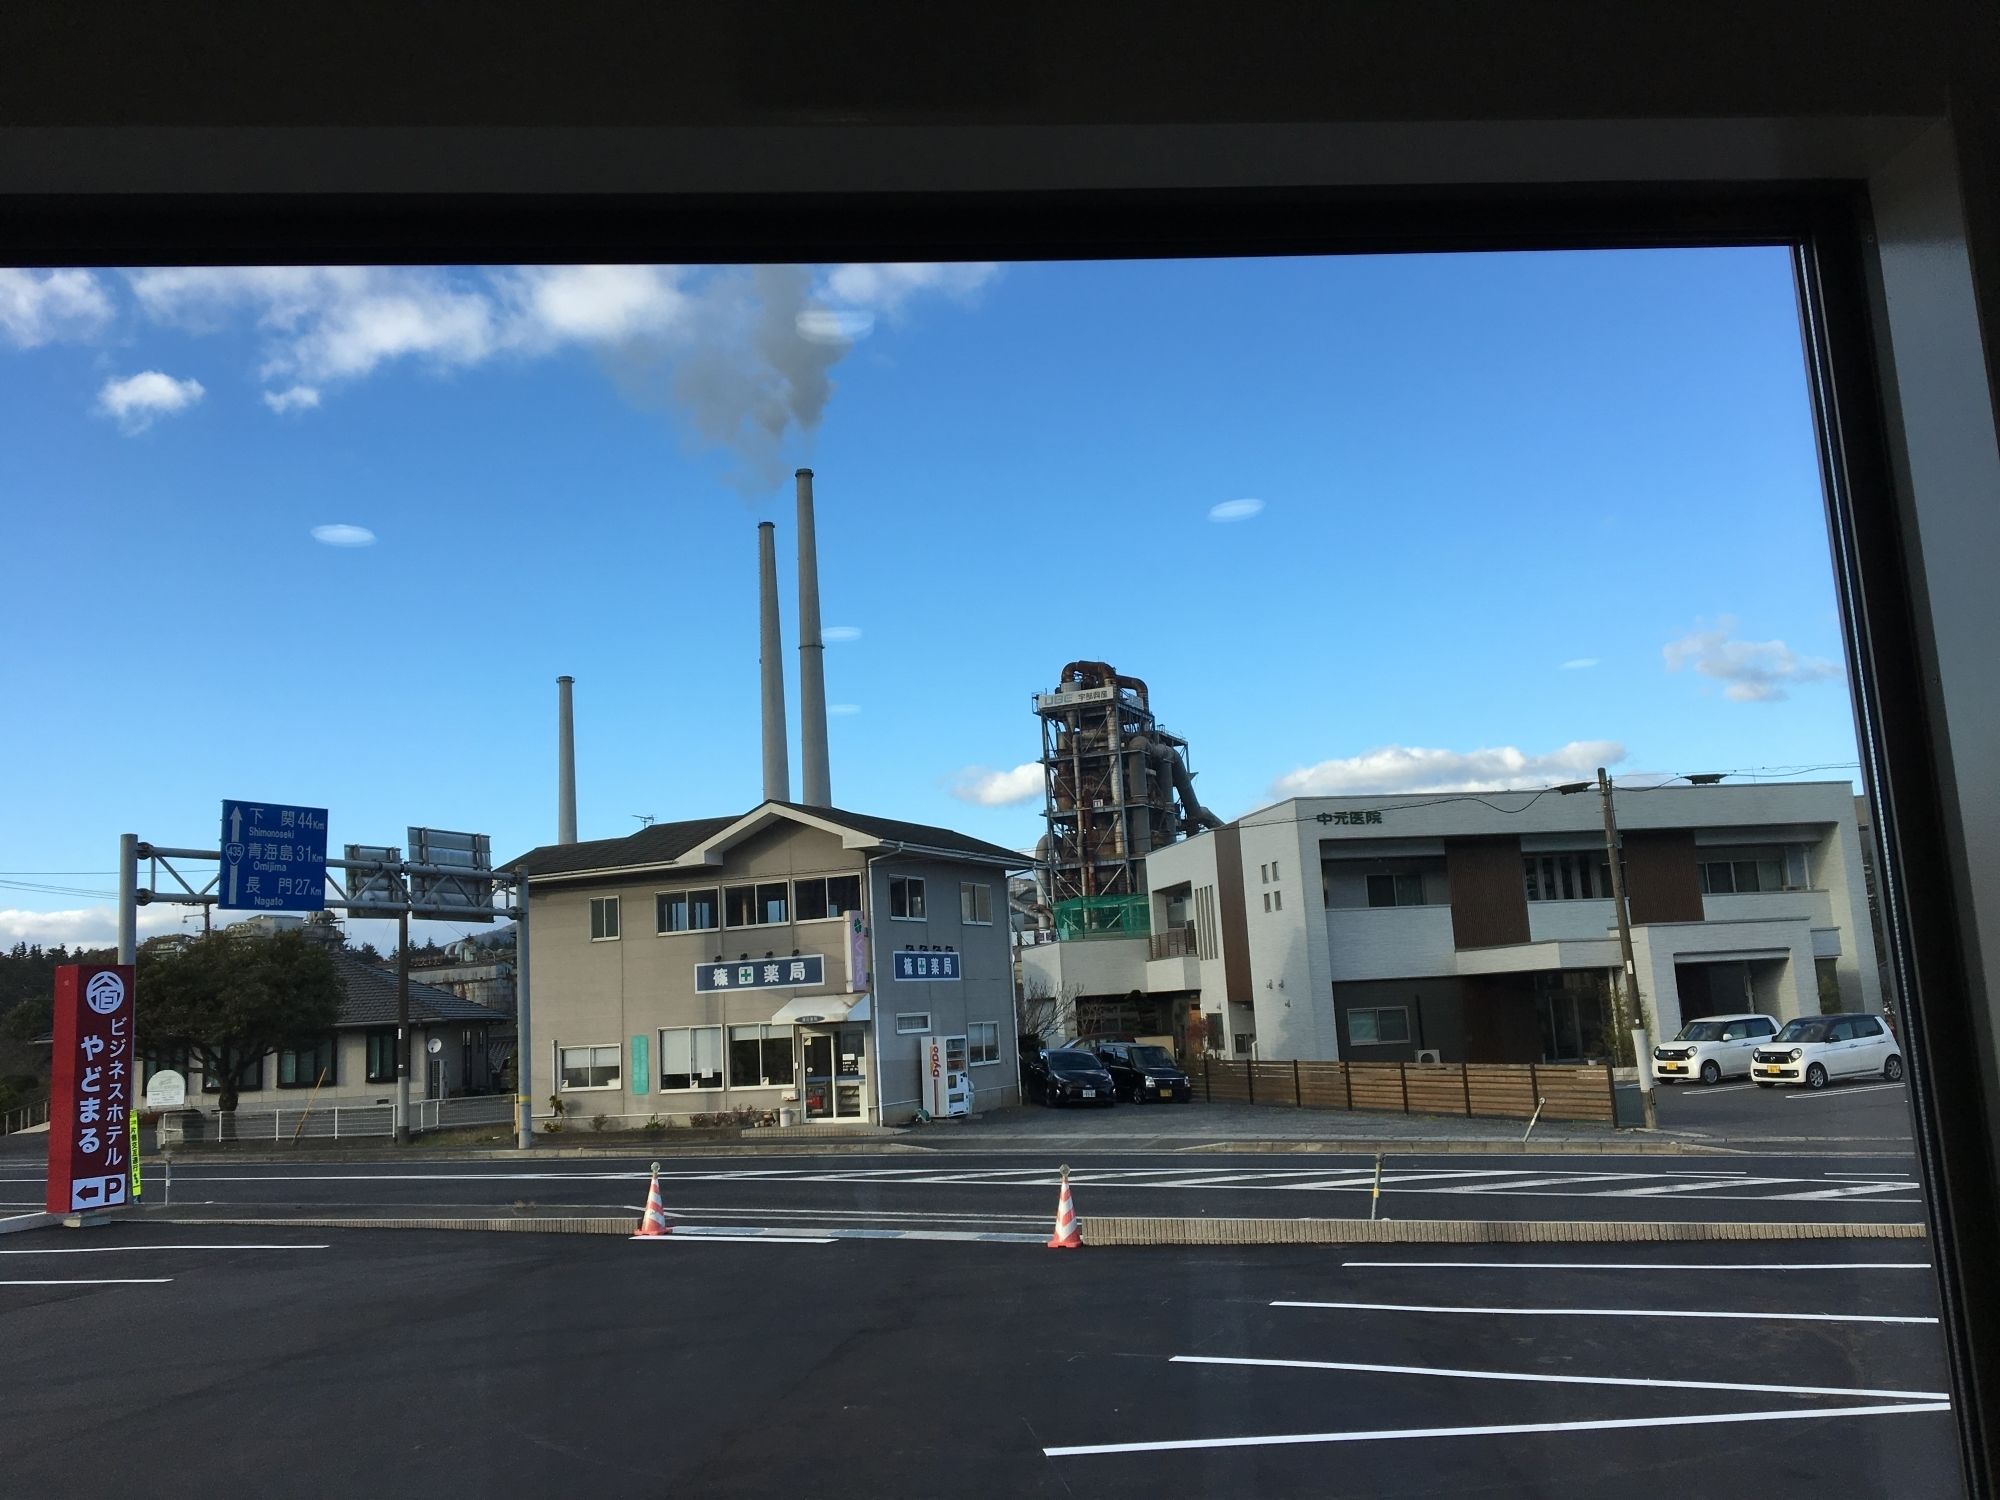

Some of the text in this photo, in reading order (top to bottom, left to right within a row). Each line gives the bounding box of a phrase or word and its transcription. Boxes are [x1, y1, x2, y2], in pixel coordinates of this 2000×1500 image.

[1316, 811, 1382, 825] 中元医院
[248, 826, 295, 839] Shimonoseki
[226, 846, 242, 856] 435
[248, 842, 293, 861] 青海島
[253, 861, 287, 872] Omijima
[254, 896, 284, 907] Nagato
[932, 1046, 941, 1078] DyDo
[78, 1034, 104, 1154] やどまる
[105, 1017, 127, 1167] ビジネスホテル
[104, 1178, 122, 1203] P
